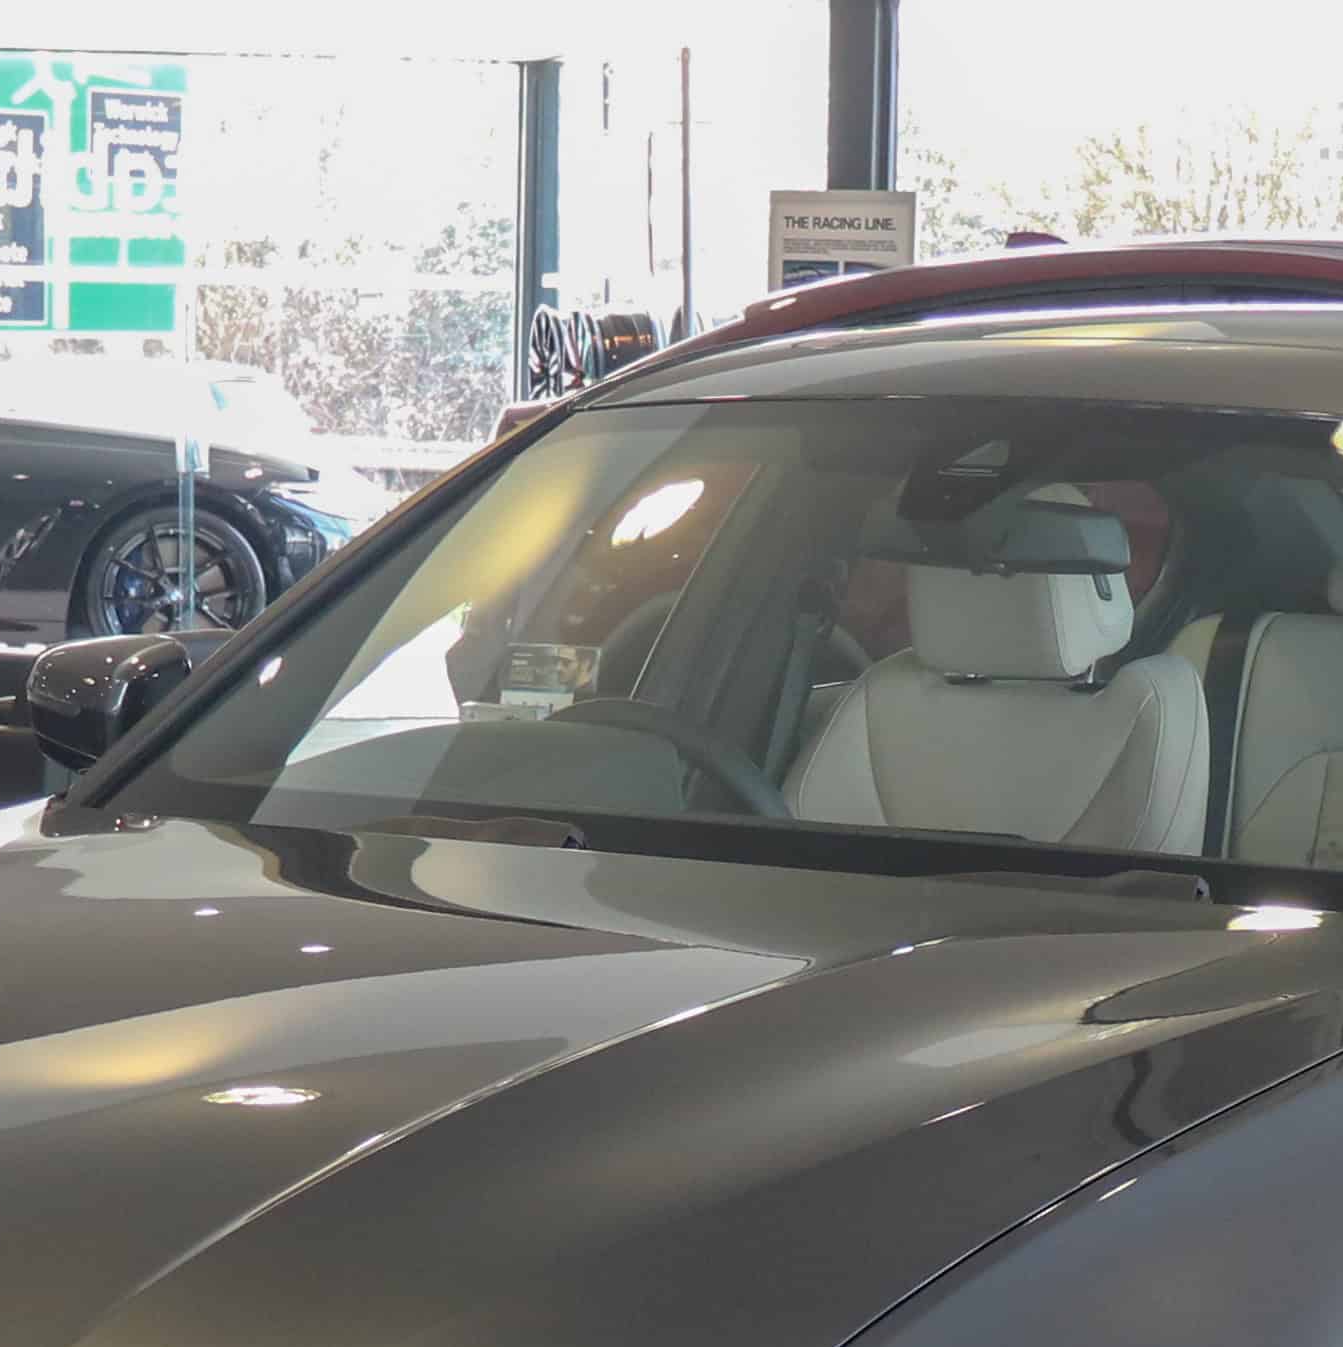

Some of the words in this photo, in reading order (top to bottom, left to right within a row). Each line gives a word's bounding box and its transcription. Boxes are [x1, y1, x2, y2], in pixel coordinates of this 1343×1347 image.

[783, 216, 809, 229] THE
[811, 216, 862, 230] RACING
[863, 216, 896, 231] LINE.
